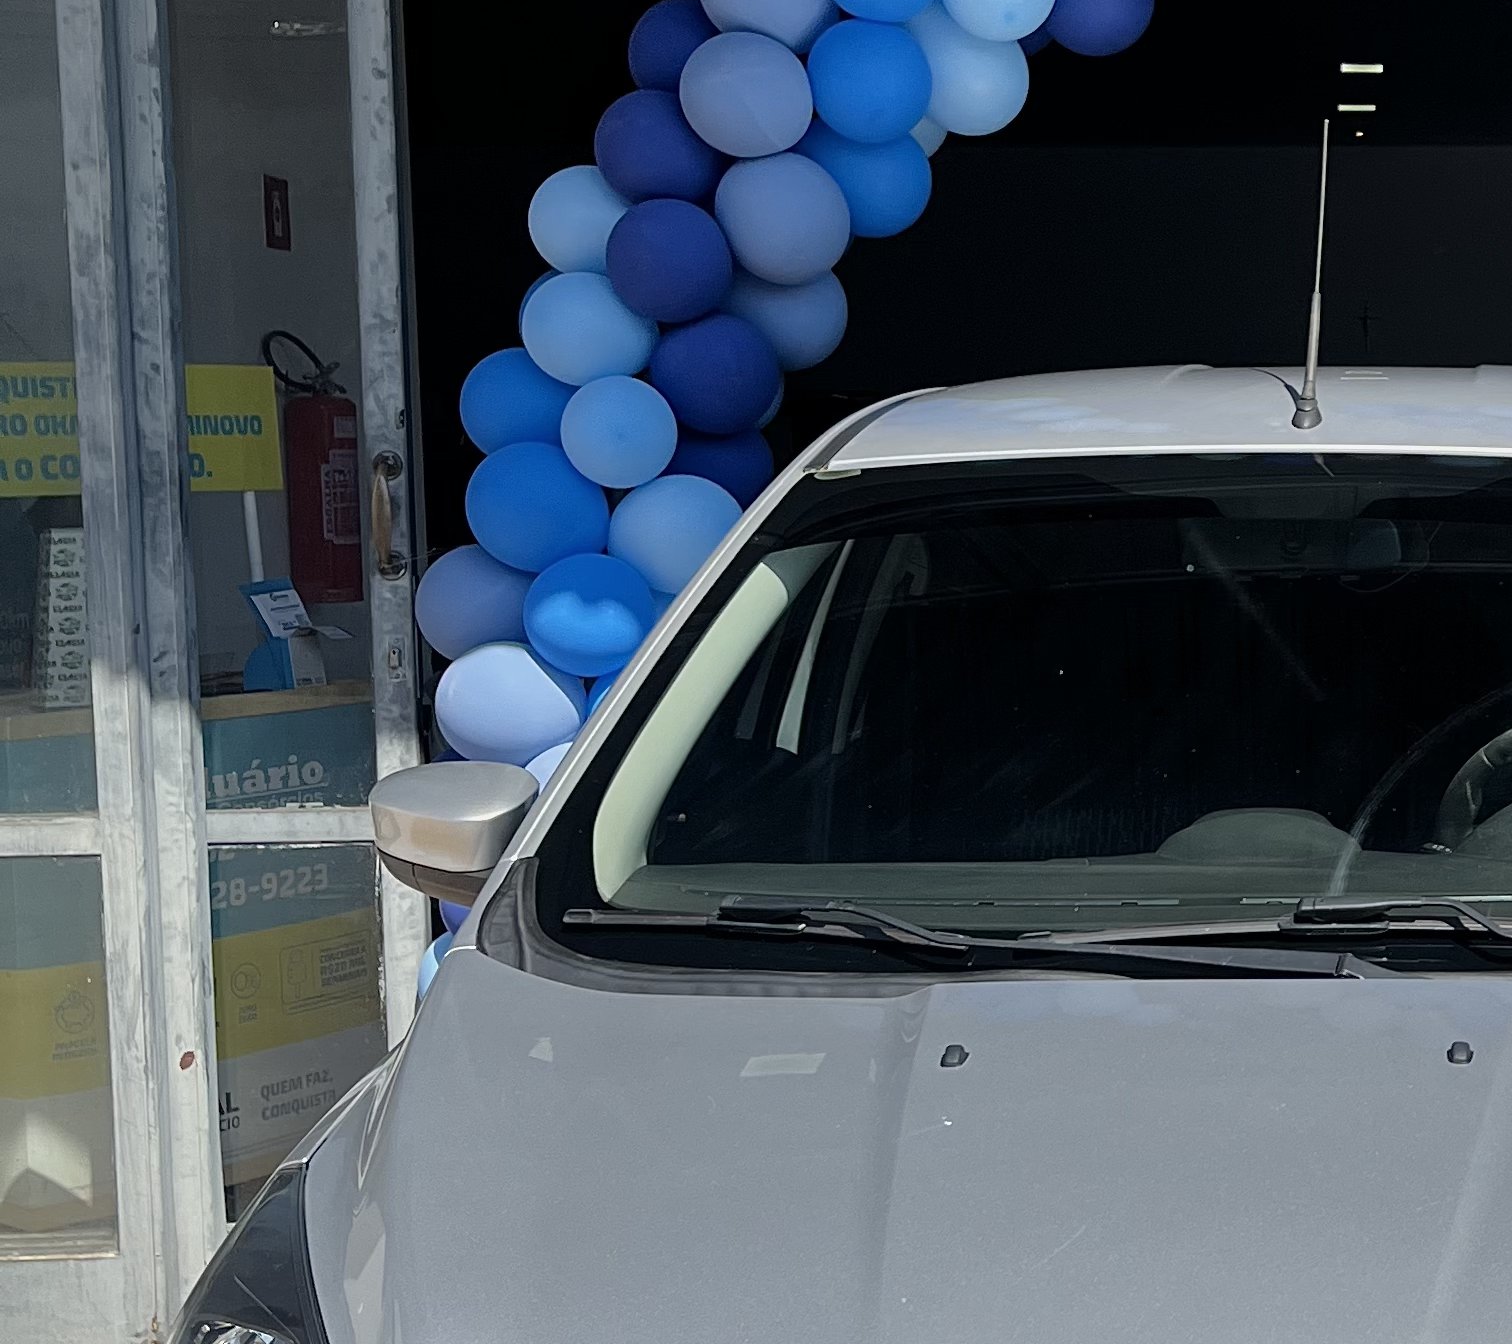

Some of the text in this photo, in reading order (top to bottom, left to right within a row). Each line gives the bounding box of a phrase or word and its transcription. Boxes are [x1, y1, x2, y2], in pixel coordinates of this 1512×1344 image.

[41, 454, 80, 480] CO
[204, 754, 324, 798] uário
[261, 1076, 303, 1100] QUEM
